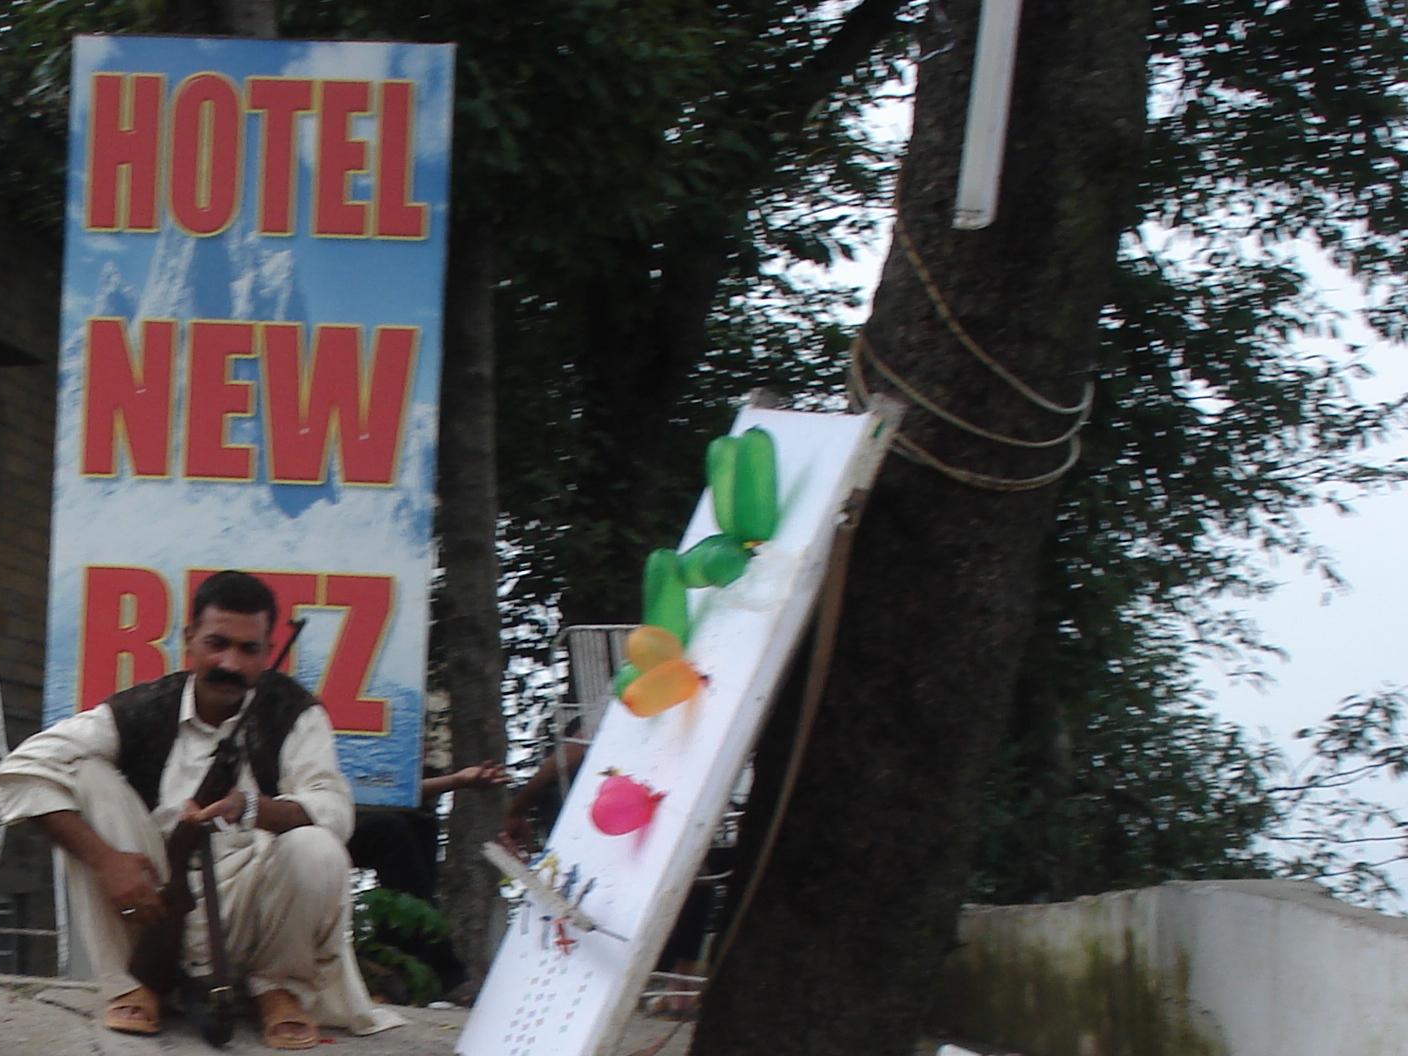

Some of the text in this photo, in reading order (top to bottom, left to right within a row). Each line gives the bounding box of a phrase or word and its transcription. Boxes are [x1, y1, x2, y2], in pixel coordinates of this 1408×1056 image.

[85, 71, 429, 241] HOTEL
[79, 316, 421, 488] NEW
[75, 564, 395, 736] RZ
